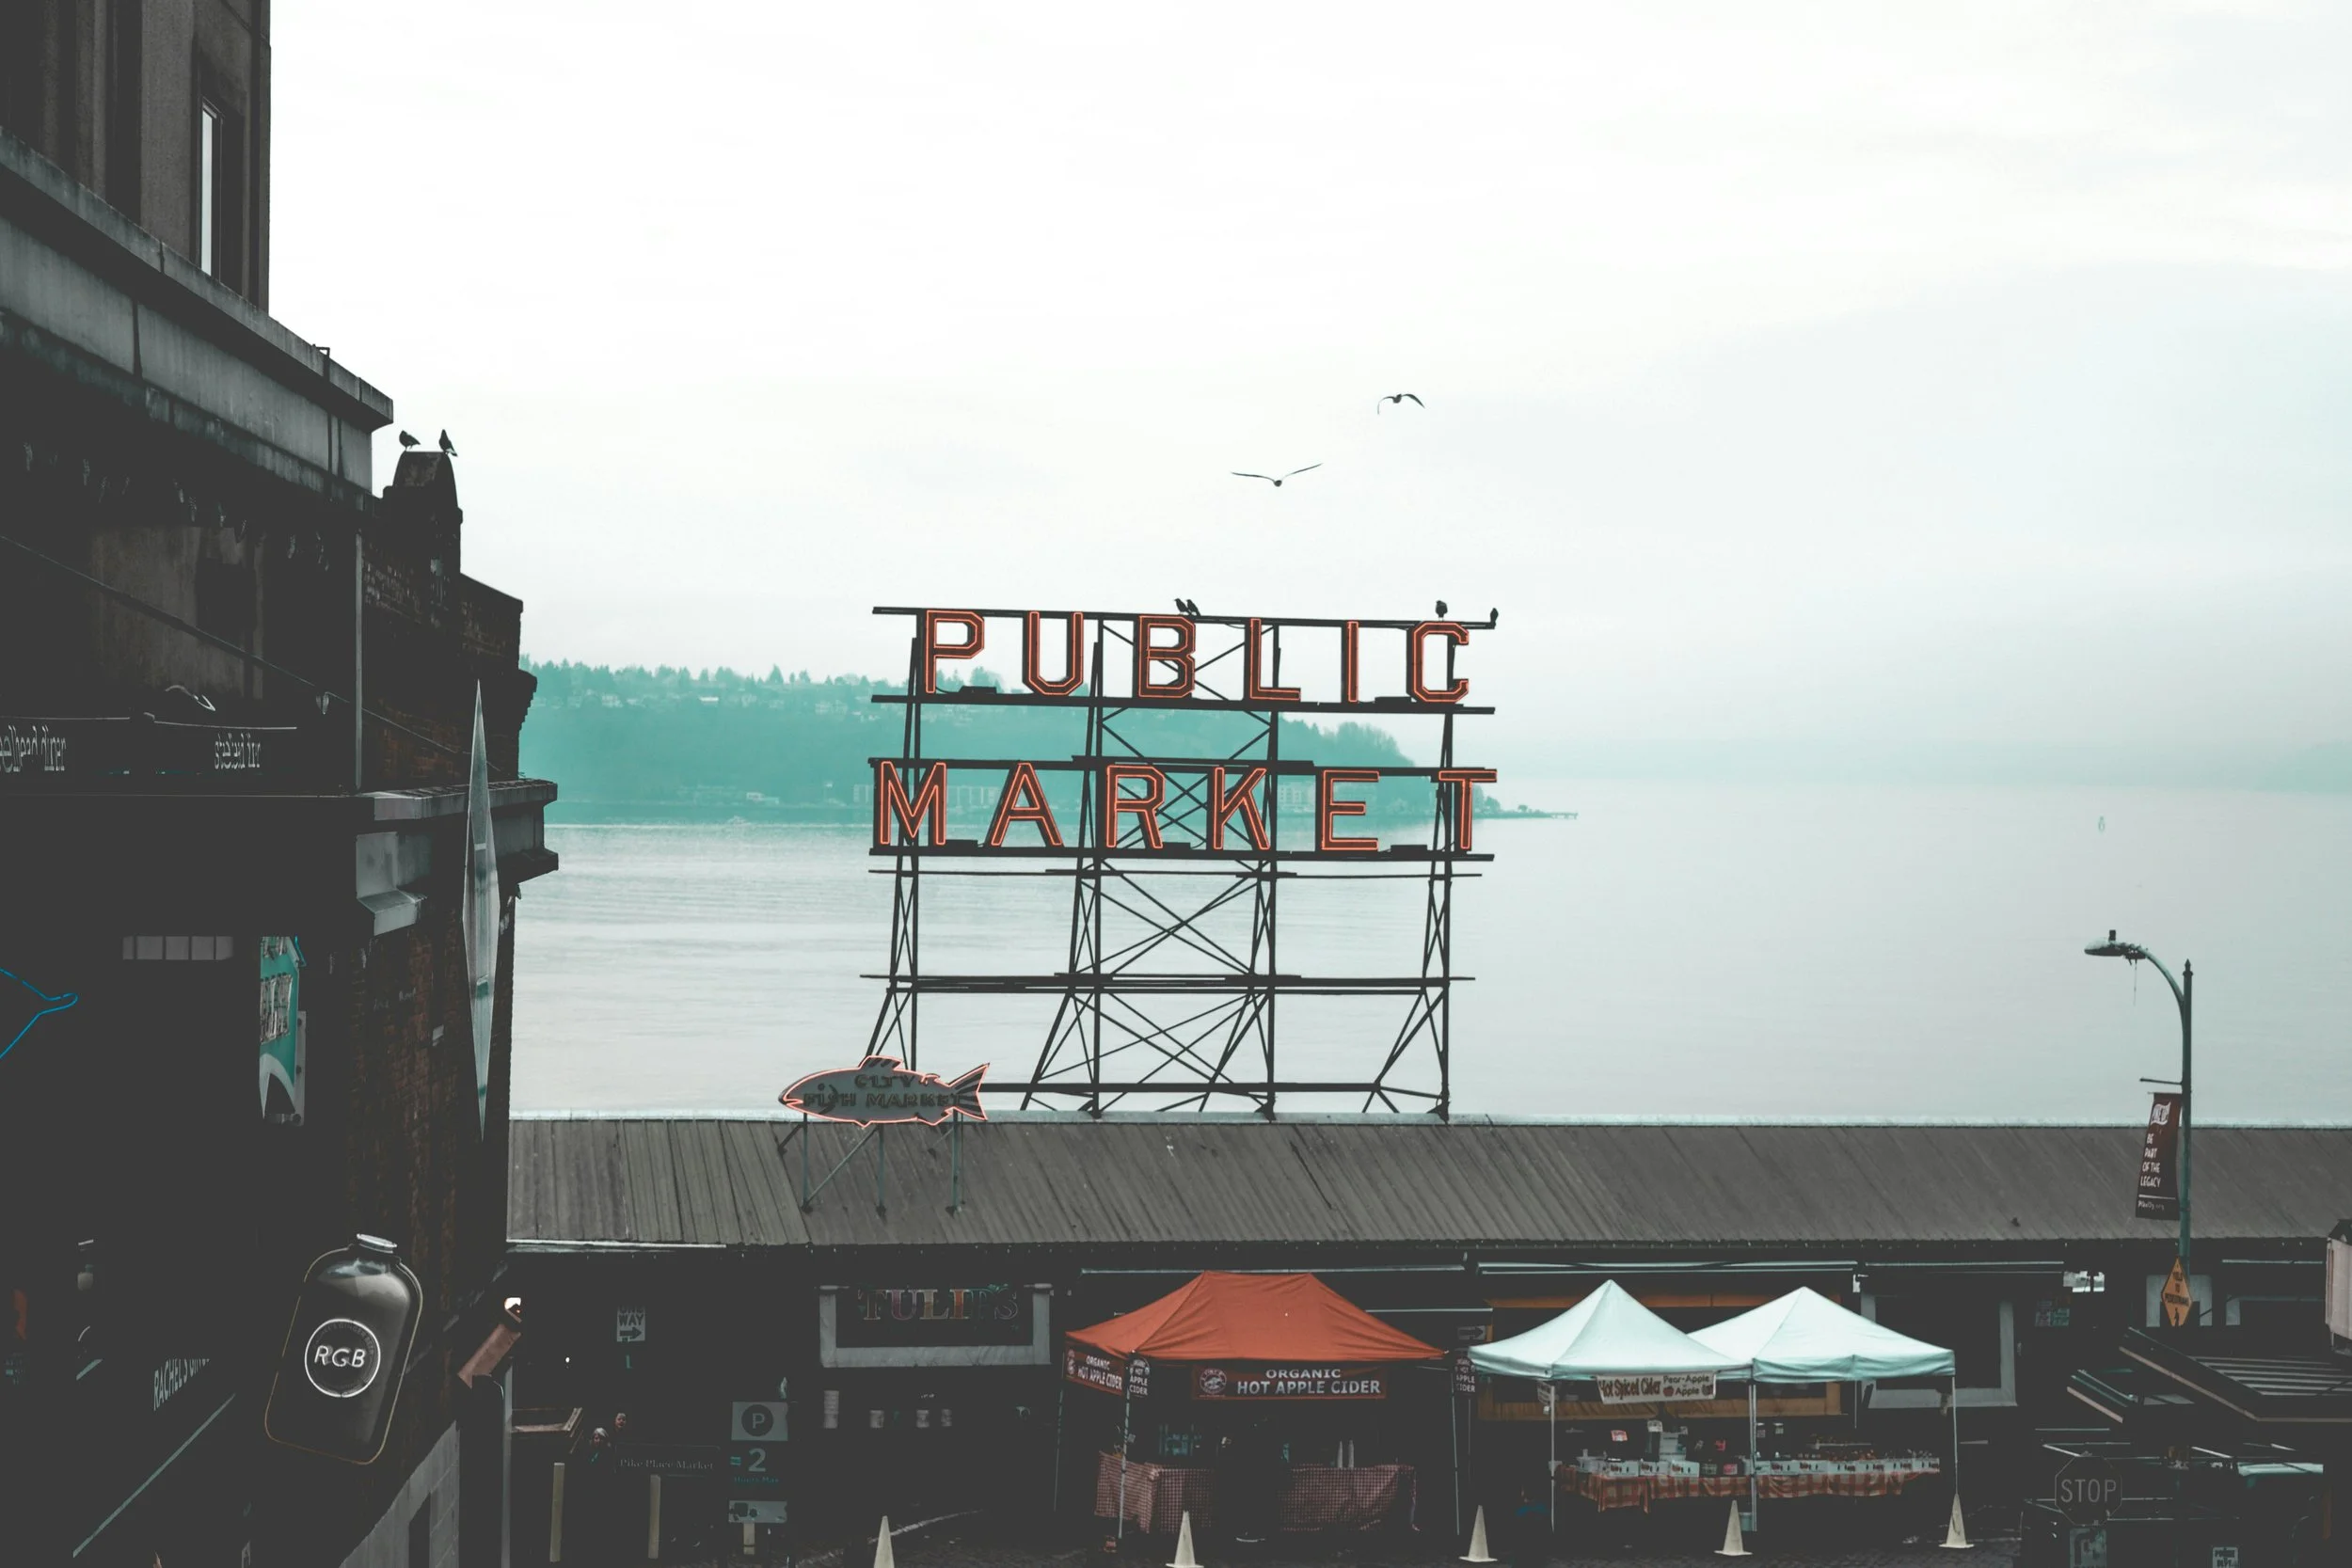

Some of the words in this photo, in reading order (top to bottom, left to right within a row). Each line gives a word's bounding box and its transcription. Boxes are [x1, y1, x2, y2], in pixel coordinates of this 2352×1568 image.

[922, 609, 1470, 704] PUBLIC
[877, 760, 1497, 850] MARKET
[854, 1073, 914, 1089] CITY
[803, 1092, 856, 1107] FISH
[865, 1092, 962, 1109] MARKET
[2144, 1148, 2158, 1159] PART
[2141, 1162, 2151, 1172] OF
[2151, 1162, 2161, 1174] THE
[2139, 1176, 2161, 1188] LEGACY
[857, 1284, 1019, 1322] TULIPS
[618, 1314, 644, 1326] WAY
[313, 1344, 367, 1369] RGB
[1086, 1354, 1110, 1370] ORGANIC
[1077, 1365, 1089, 1380] HOT
[1089, 1368, 1106, 1386] APPLE
[1105, 1372, 1122, 1390] CIDER
[1129, 1374, 1148, 1386] APPLE
[1265, 1369, 1342, 1379] ORGANIC
[1129, 1385, 1148, 1396] CIDER
[1237, 1381, 1270, 1395] HOT
[1275, 1380, 1326, 1395] APPLE
[1330, 1380, 1381, 1395] CIDER
[1613, 1378, 1639, 1401] Spiced
[1641, 1377, 1661, 1396] Cider
[1675, 1386, 1700, 1397] Apple
[752, 1412, 766, 1430] P
[619, 1458, 643, 1468] Pike
[676, 1460, 714, 1470] Market
[748, 1448, 767, 1473] 2
[2060, 1478, 2117, 1503] STOP
